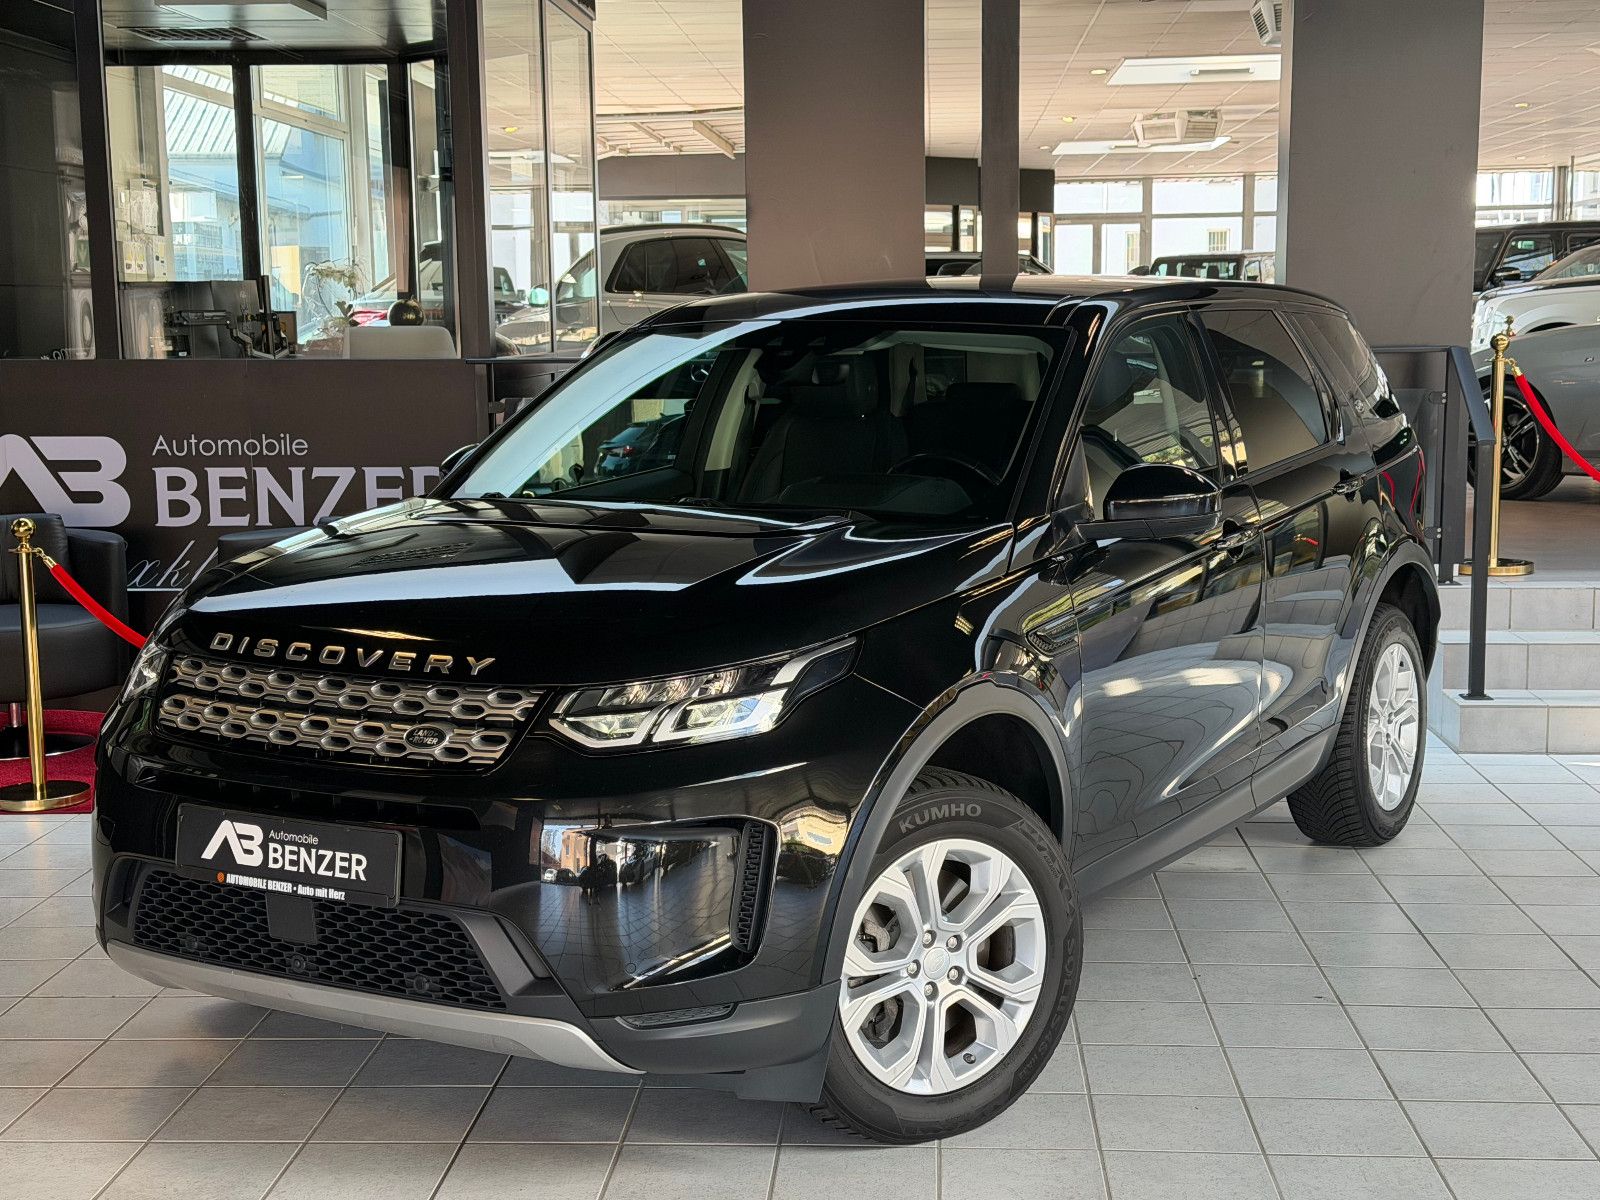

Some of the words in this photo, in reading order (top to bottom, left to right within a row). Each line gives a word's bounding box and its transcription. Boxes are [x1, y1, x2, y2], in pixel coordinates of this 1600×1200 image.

[152, 434, 309, 457] Automobile
[209, 632, 497, 676] DISCOVERY
[412, 736, 439, 745] ROVER
[898, 802, 982, 834] KUMHO
[201, 819, 264, 867] AB
[268, 829, 319, 846] Automobile
[267, 842, 368, 882] BENZER
[226, 873, 267, 889] AUTOMOBILE
[267, 881, 293, 893] BENZER
[297, 884, 315, 896] Auto
[315, 887, 328, 898] mit
[328, 888, 346, 900] Herz
